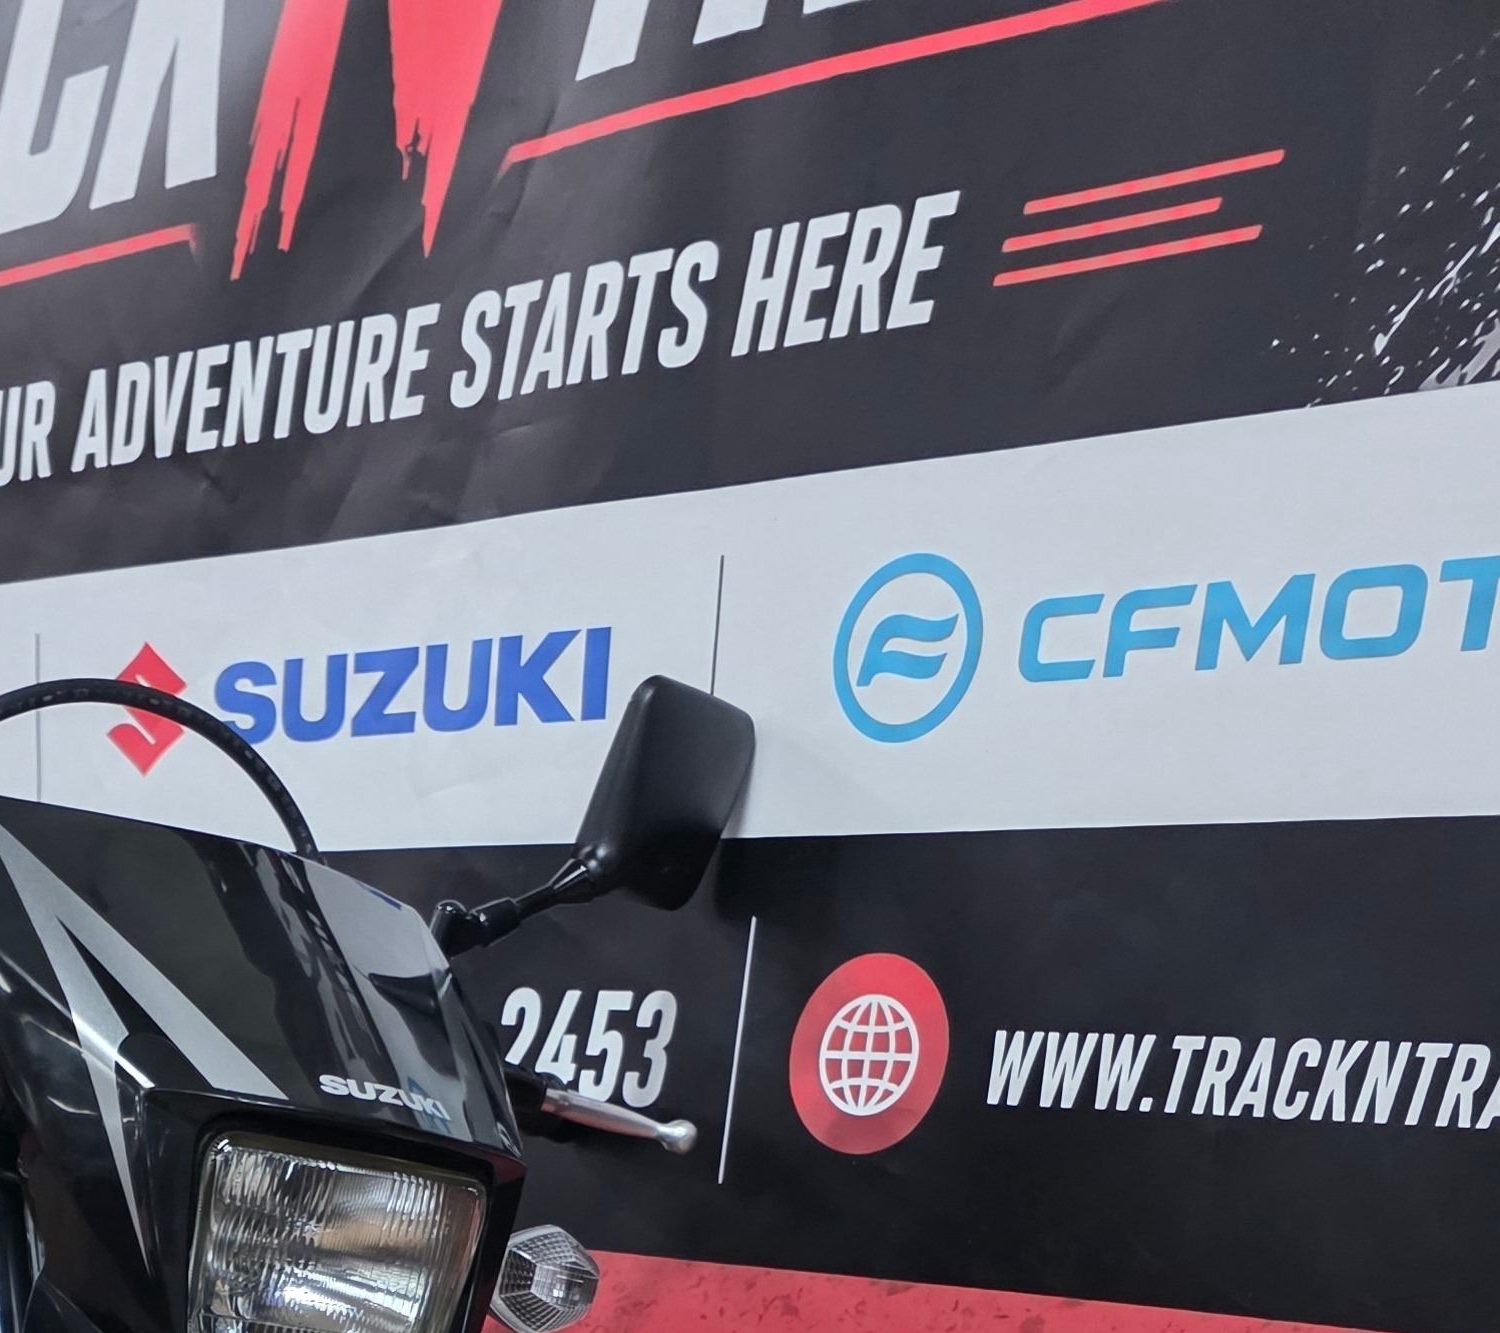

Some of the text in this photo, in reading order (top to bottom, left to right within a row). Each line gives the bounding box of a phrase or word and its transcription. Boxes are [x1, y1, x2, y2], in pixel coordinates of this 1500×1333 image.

[71, 303, 441, 473] ADVENTURE
[450, 241, 719, 410] STARTS
[731, 190, 961, 358] HERE
[214, 626, 612, 746] SUZUKI
[319, 1074, 451, 1121] SUZUKI
[501, 986, 678, 1108] 2453
